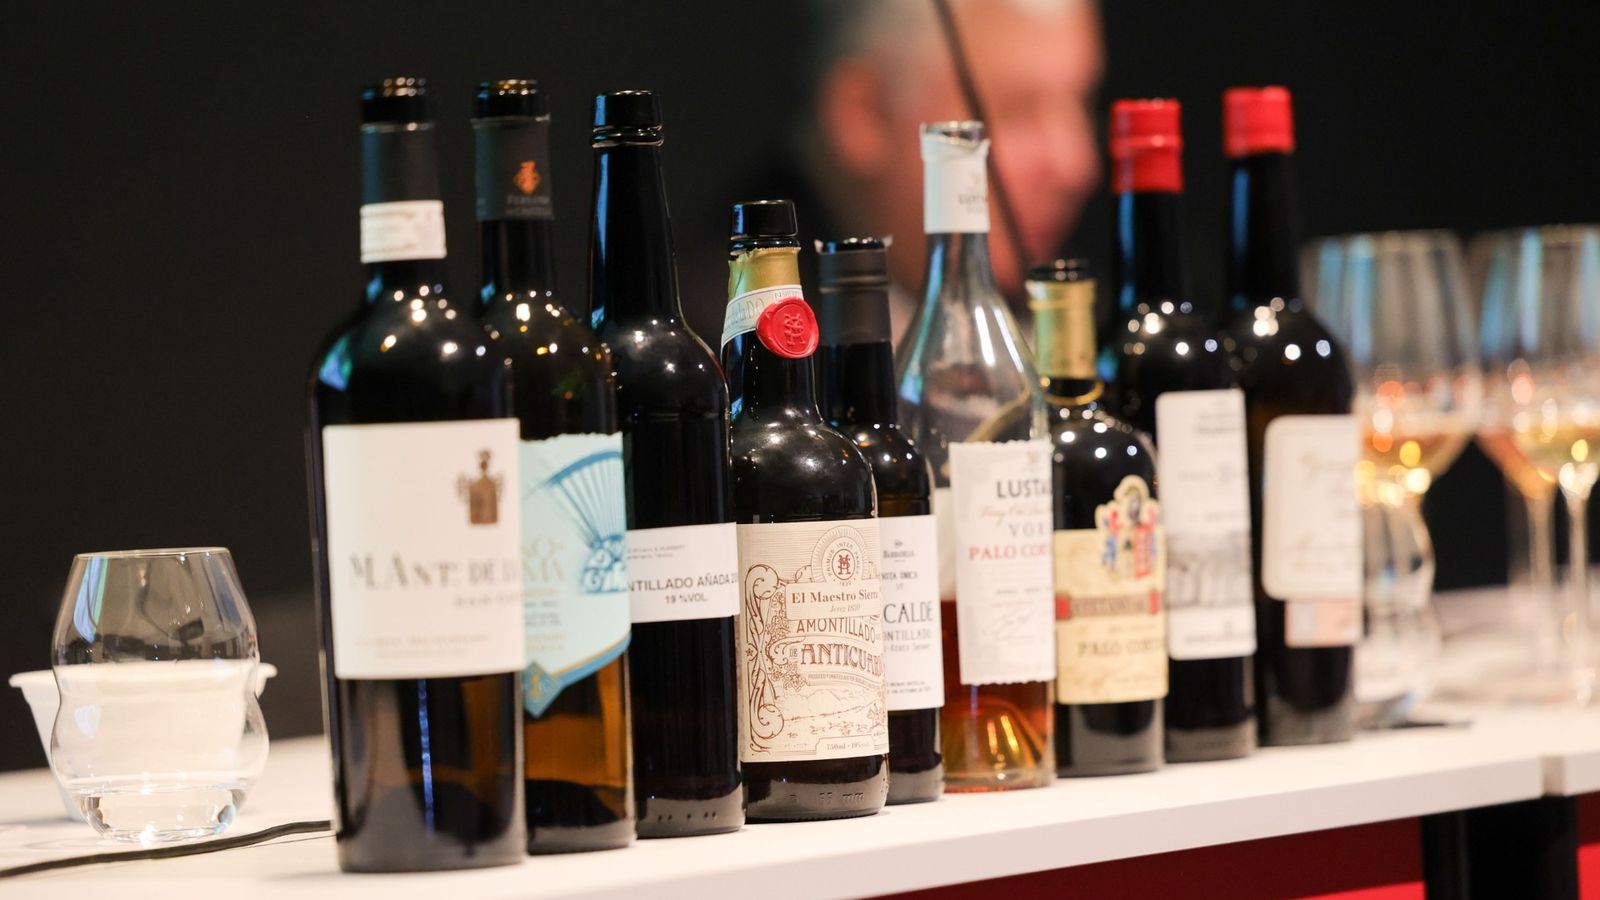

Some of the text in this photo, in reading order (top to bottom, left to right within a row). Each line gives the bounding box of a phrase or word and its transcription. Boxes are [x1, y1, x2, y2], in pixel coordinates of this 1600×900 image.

[996, 479, 1051, 498] LUSTA
[968, 545, 1018, 560] PALO
[697, 573, 729, 587] AÑADA
[665, 594, 676, 604] 19
[792, 592, 805, 604] El
[810, 590, 856, 603] Maestro
[796, 616, 876, 643] AMONTILLADO
[789, 648, 798, 657] DE
